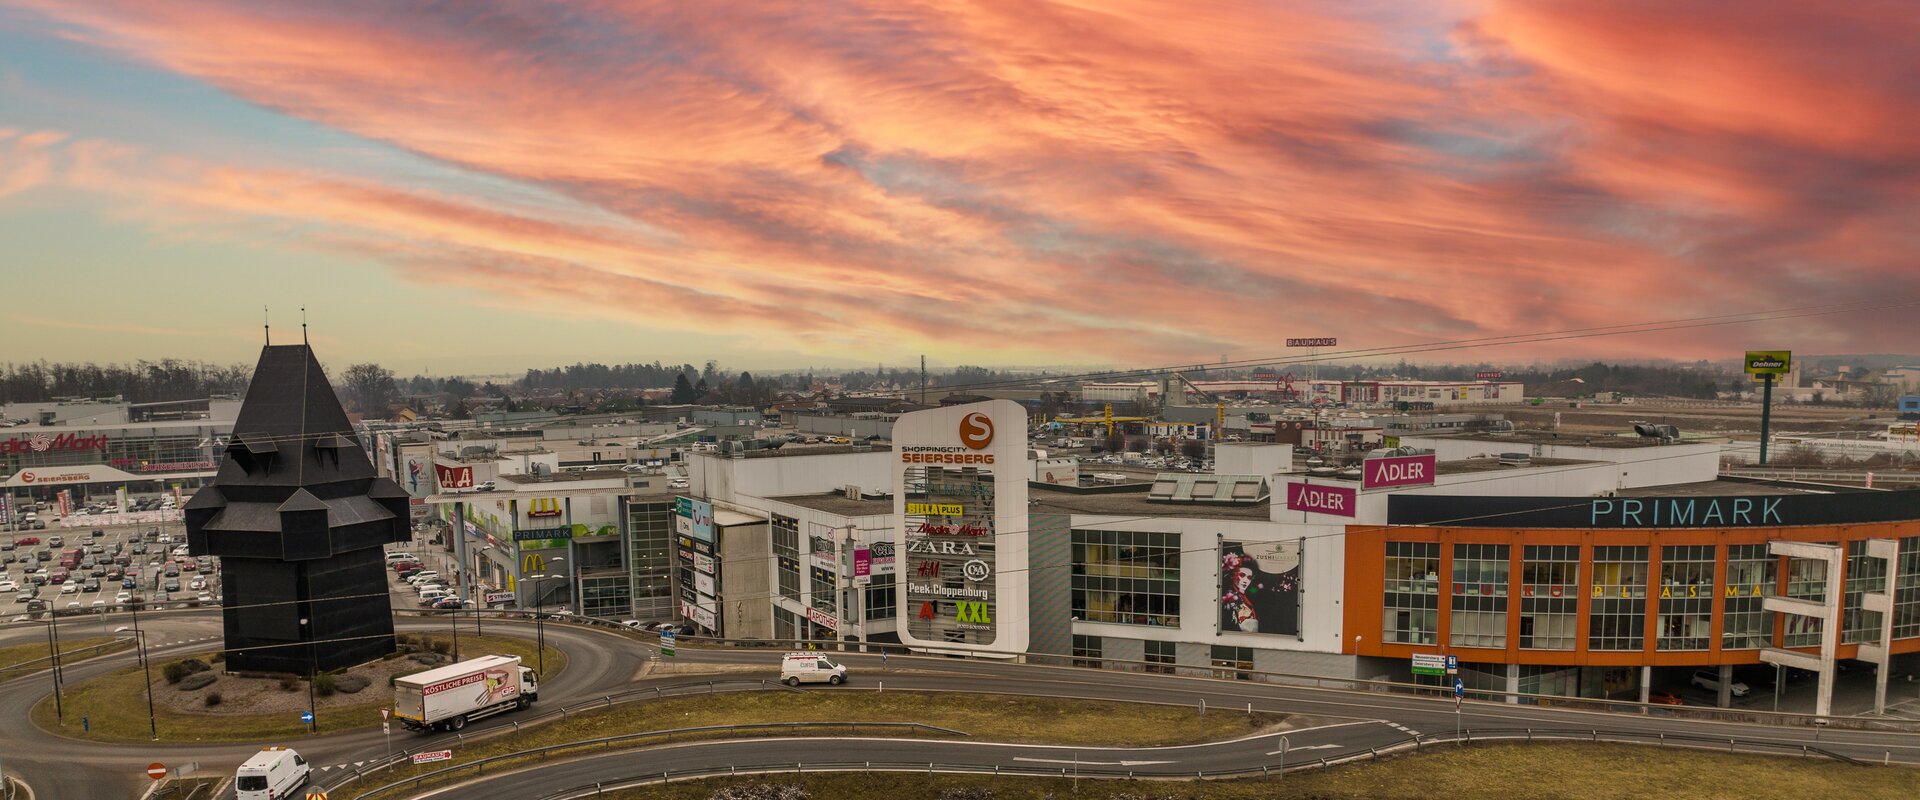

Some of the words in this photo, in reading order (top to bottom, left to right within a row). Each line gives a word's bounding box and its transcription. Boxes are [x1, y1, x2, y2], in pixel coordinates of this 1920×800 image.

[1286, 338, 1336, 347] BAUHAUS
[902, 454, 995, 464] SEIERSBERG
[1375, 462, 1424, 483] ADLER
[914, 484, 992, 496] PRIMARK
[1297, 486, 1344, 510] ADLER
[907, 503, 940, 515] BILLA
[1591, 498, 1782, 525] PRIMARK
[515, 529, 570, 540] PRIMARK
[908, 541, 975, 555] ZARA
[955, 601, 991, 623] XXL
[425, 681, 462, 695] KÖSTLICHE
[461, 673, 484, 685] PREISE
[501, 686, 515, 695] GP
